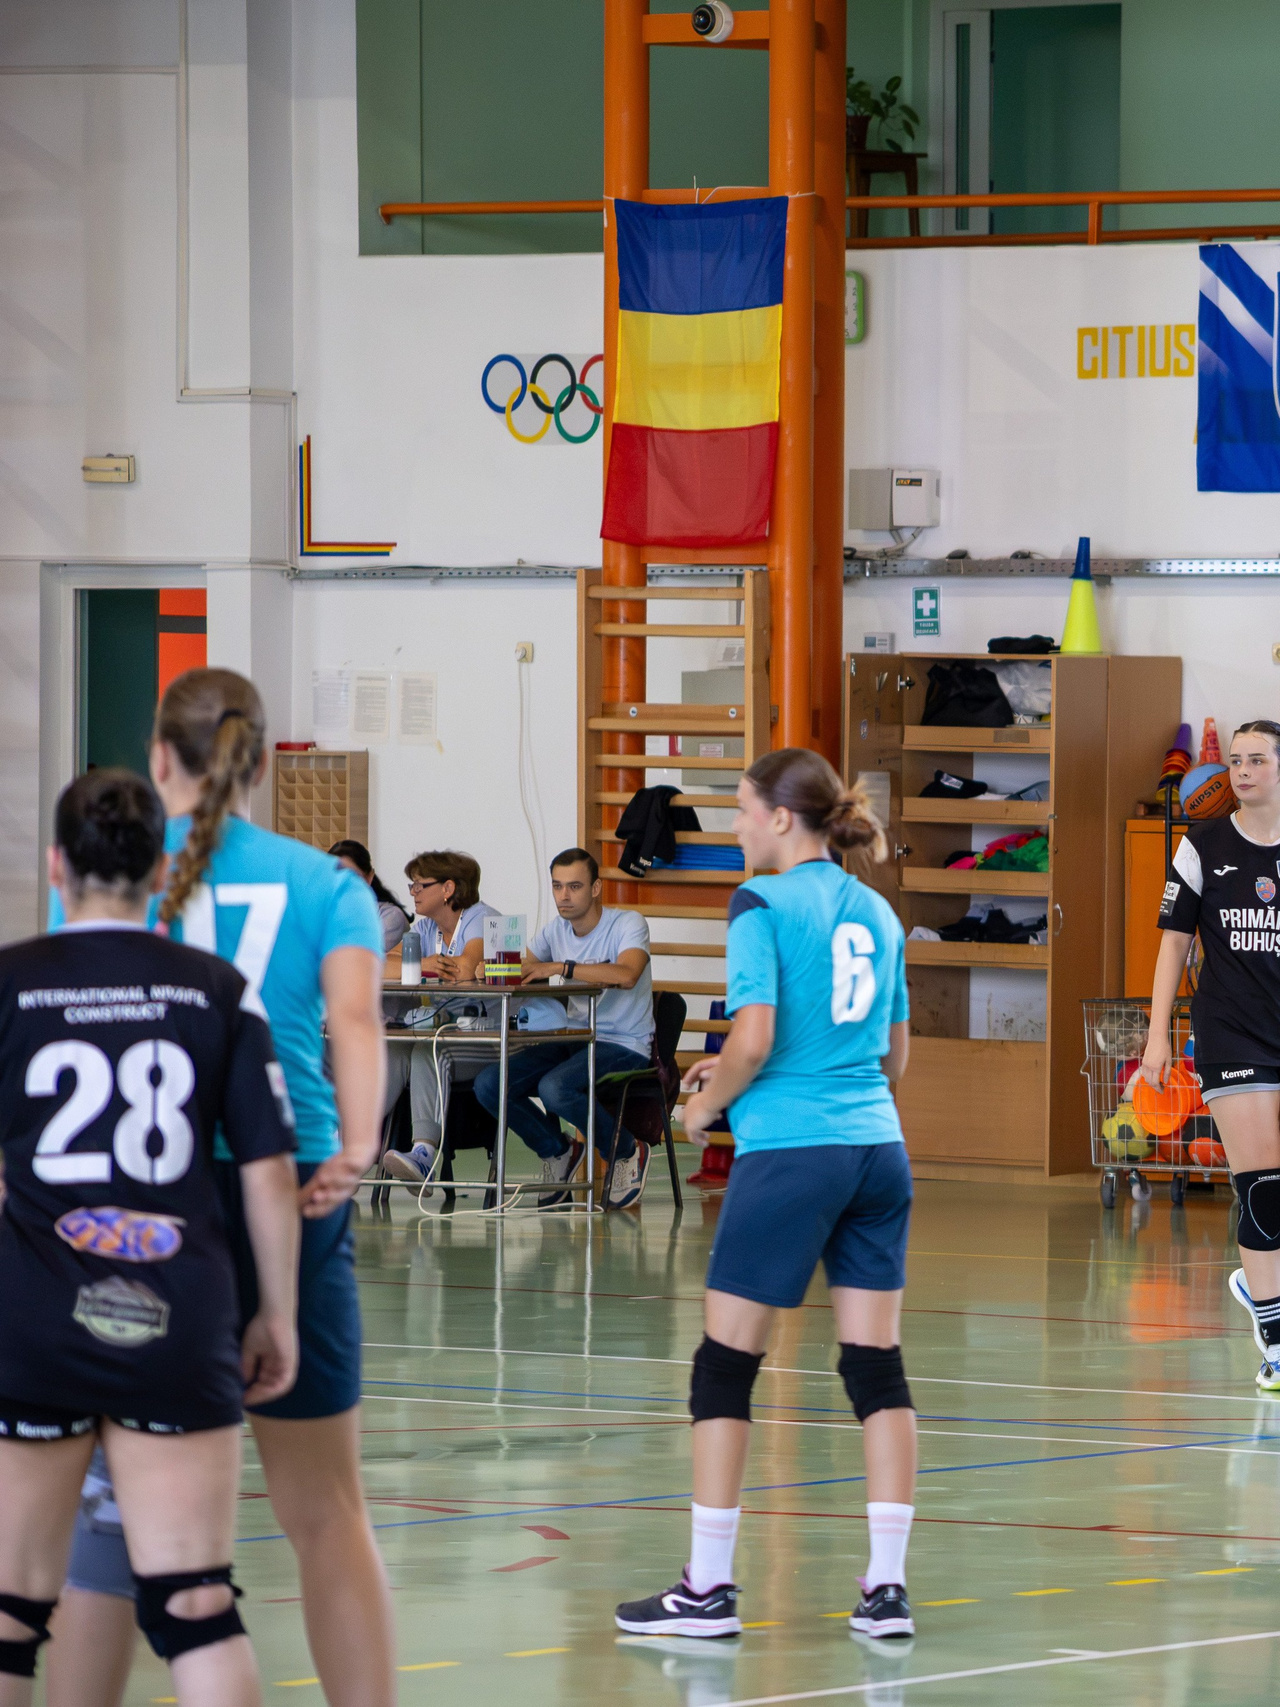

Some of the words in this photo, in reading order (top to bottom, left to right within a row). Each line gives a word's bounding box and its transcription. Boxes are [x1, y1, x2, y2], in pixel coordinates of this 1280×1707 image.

[1077, 324, 1195, 379] CITIUS
[1189, 780, 1223, 811] KIPSTA
[182, 882, 288, 1022] 17
[831, 922, 876, 1026] 6
[25, 1039, 196, 1185] 28
[1221, 1068, 1255, 1080] Kempa
